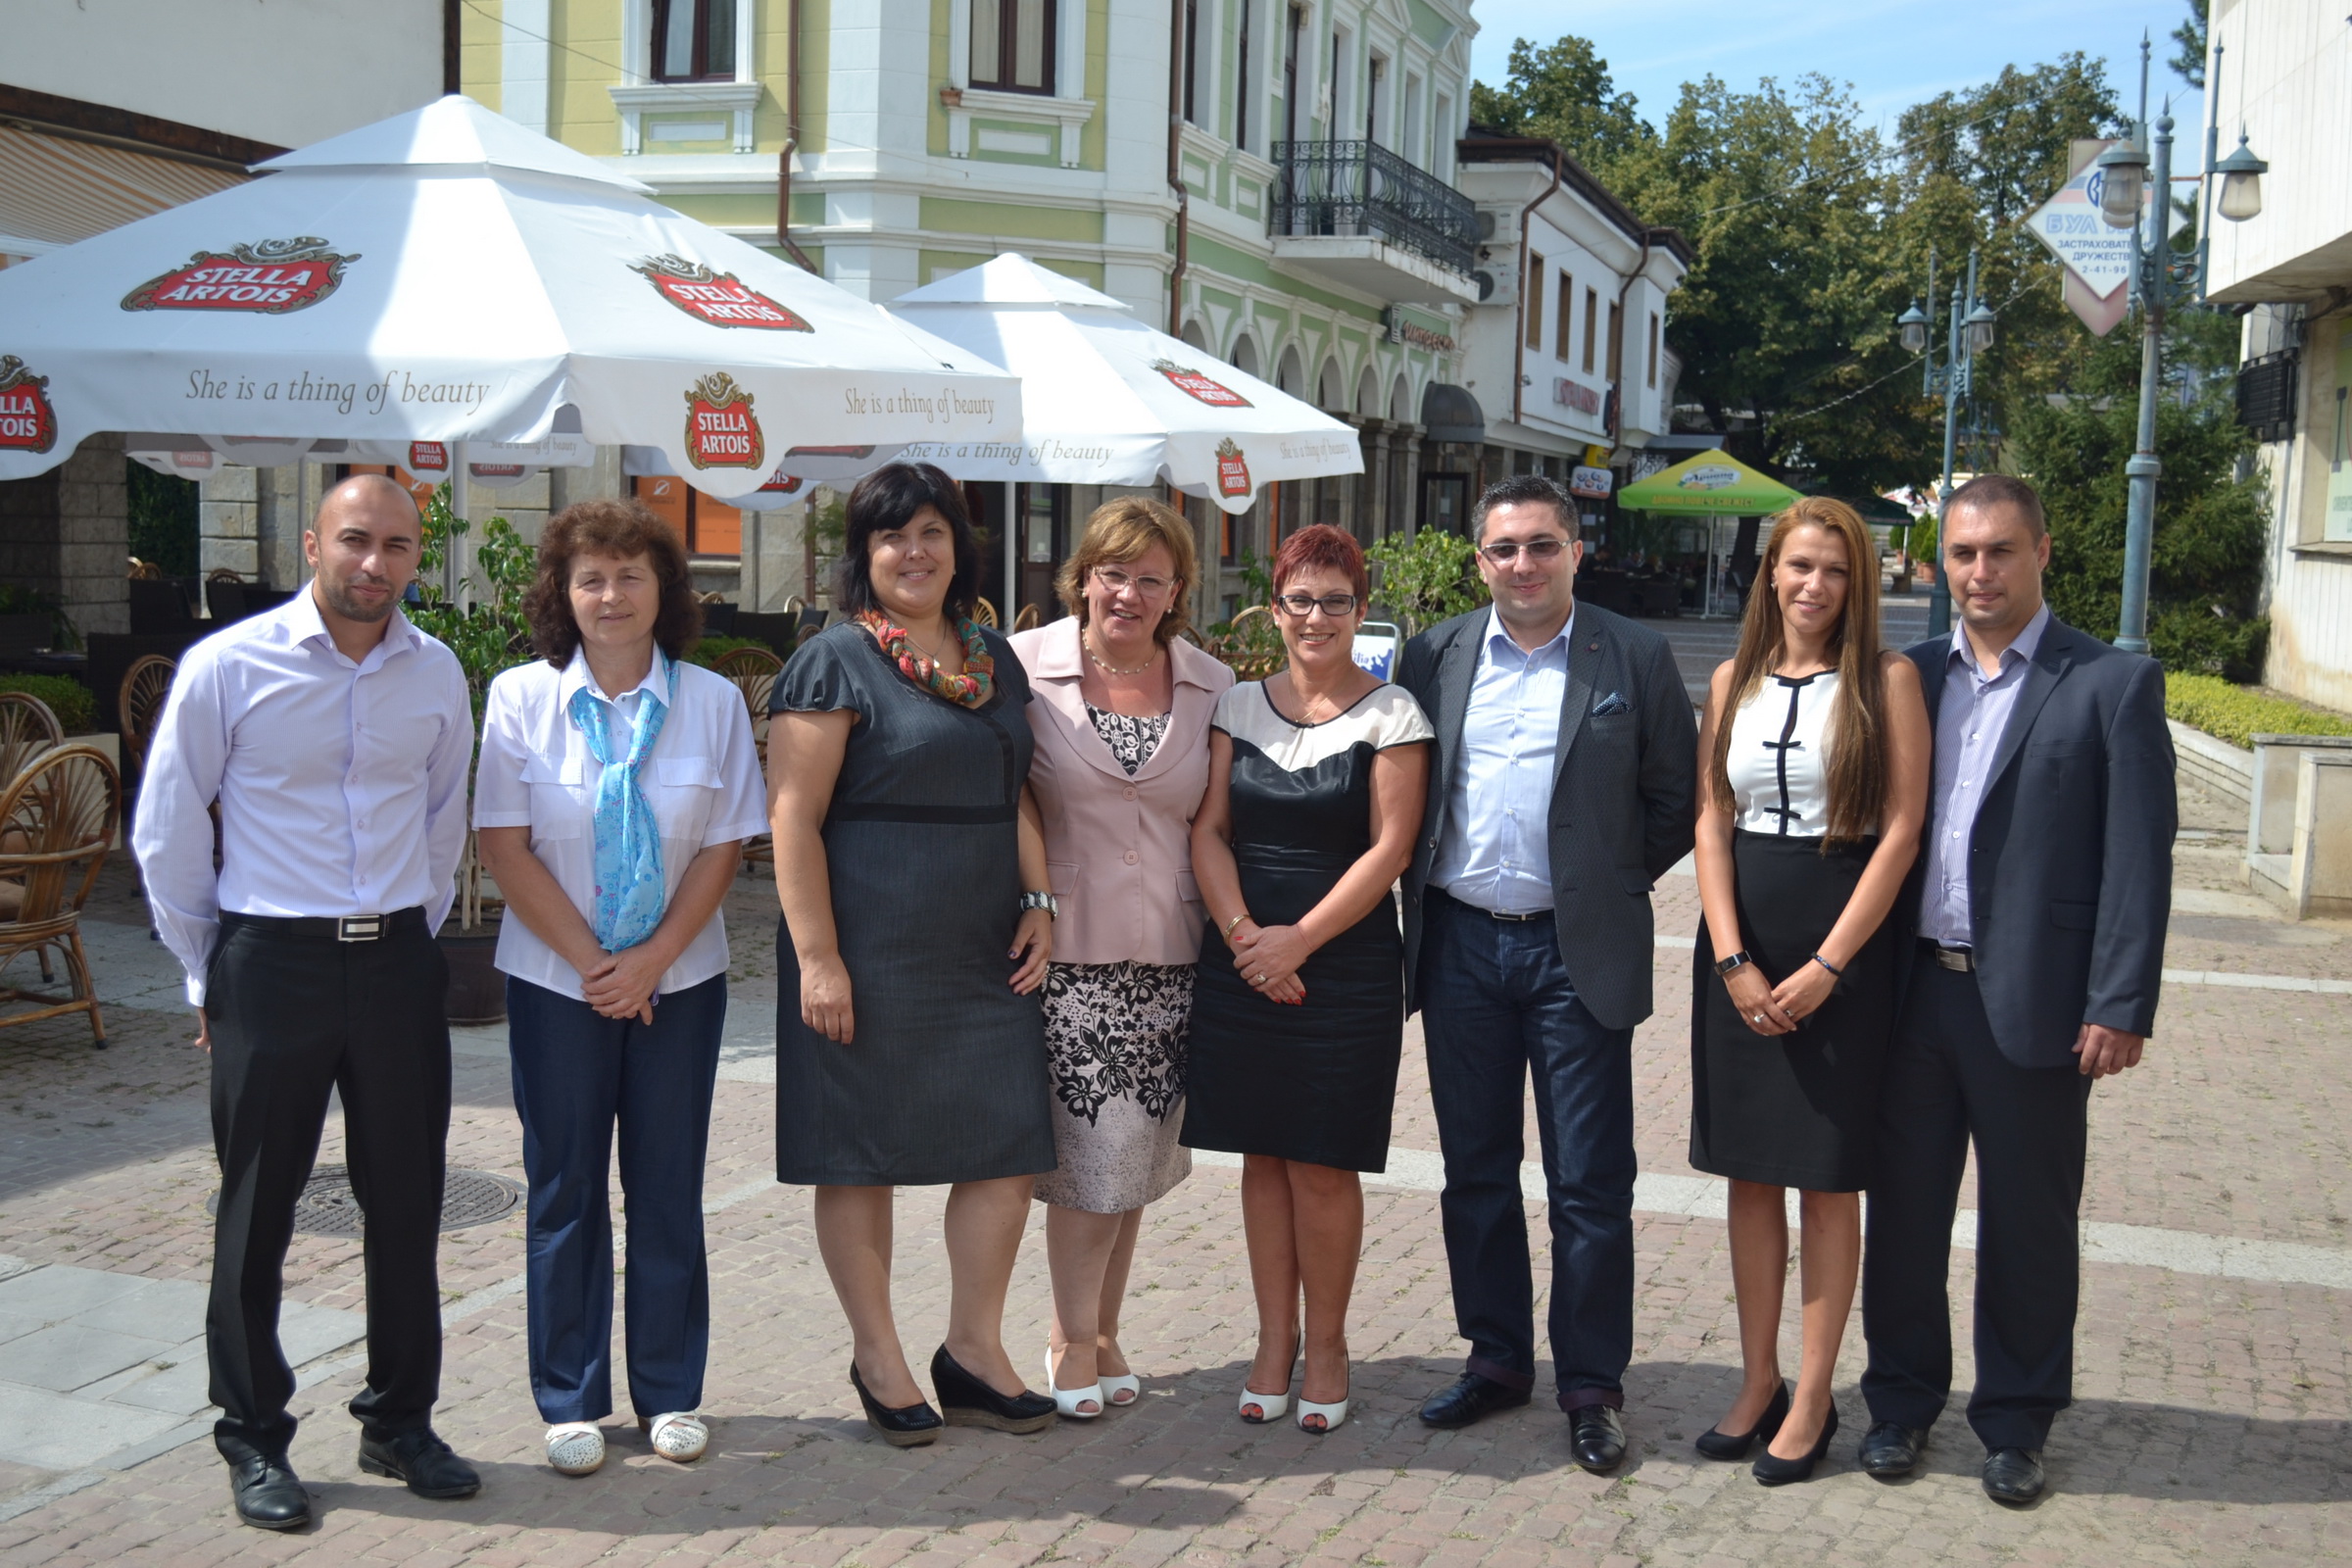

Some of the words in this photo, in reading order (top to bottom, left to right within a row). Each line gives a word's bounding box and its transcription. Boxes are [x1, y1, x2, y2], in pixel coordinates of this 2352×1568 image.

[2046, 214, 2098, 234] БУЛ
[2073, 252, 2131, 262] ДРУЖЕСТВ
[185, 267, 312, 286] STELLA
[160, 286, 299, 304] ARTOIS
[668, 283, 760, 305] STELLA
[697, 302, 785, 321] ARTOIS
[185, 369, 227, 399] She
[235, 375, 255, 400] is
[264, 382, 279, 400] a
[287, 371, 356, 415] thing
[366, 369, 398, 416] of
[401, 371, 491, 416] beauty
[0, 396, 37, 415] LLA
[845, 387, 866, 415] She
[871, 393, 882, 414] is
[887, 401, 894, 414] a
[898, 388, 934, 423] thing
[937, 388, 951, 423] of
[953, 390, 995, 424] beauty
[2, 417, 37, 437] OIS
[698, 413, 749, 432] STELLA
[416, 443, 441, 454] STELLA
[702, 434, 751, 454] ARTOIS
[901, 443, 931, 459] She
[938, 443, 951, 458] is
[956, 446, 968, 459] a
[974, 443, 1023, 466] thing
[1028, 439, 1052, 466] of
[1053, 439, 1114, 468] beauty
[416, 455, 443, 466] ARTOIS
